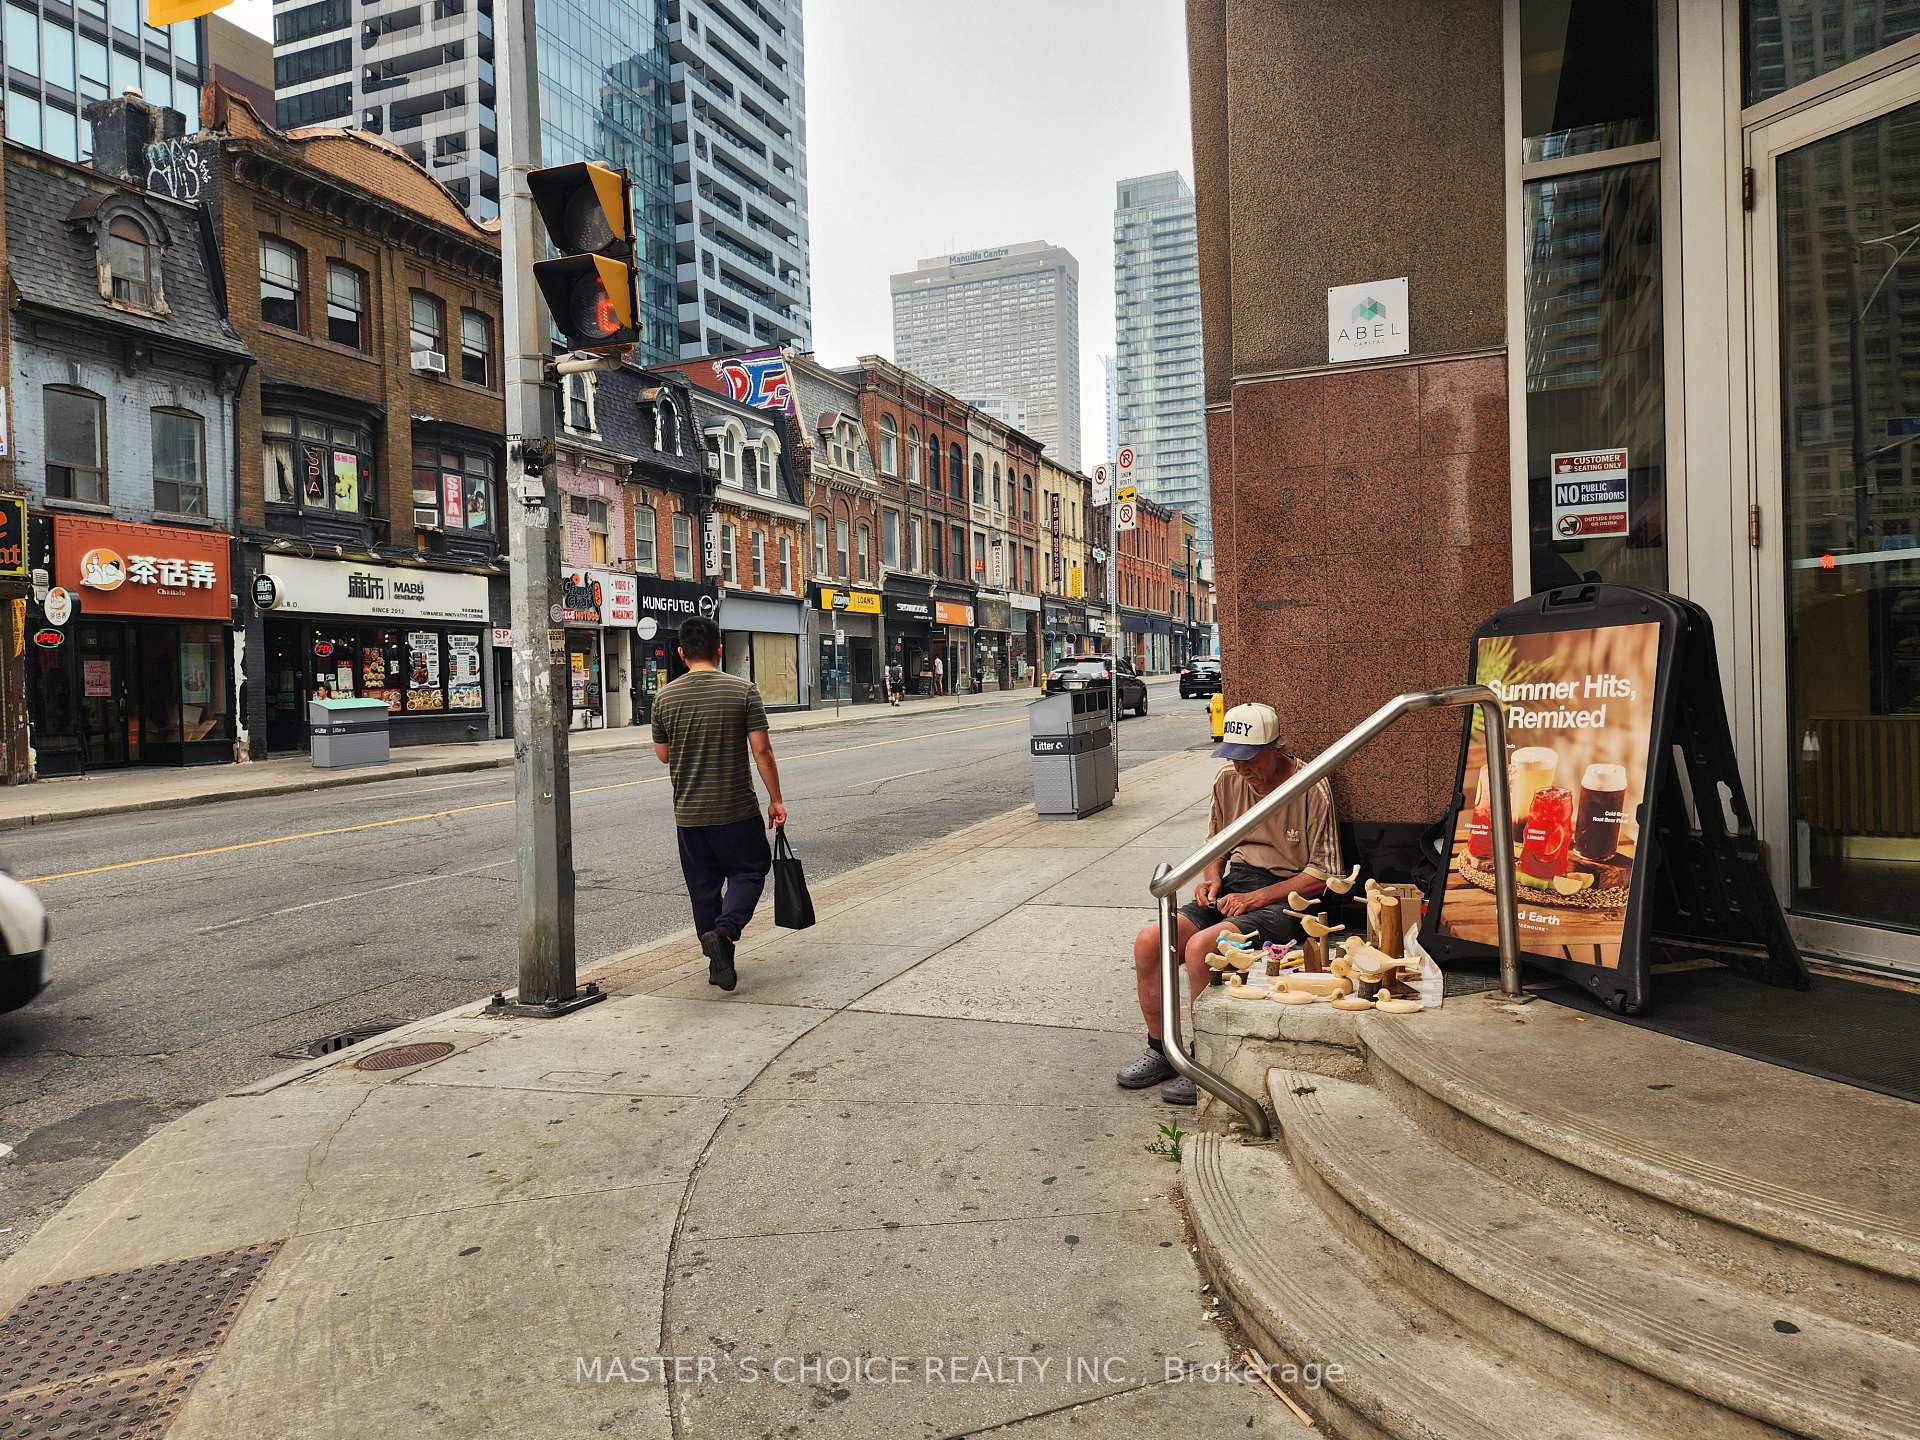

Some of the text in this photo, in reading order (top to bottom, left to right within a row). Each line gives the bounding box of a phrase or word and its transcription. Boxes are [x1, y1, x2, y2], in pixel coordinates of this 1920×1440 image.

[949, 249, 1009, 264] Manulife Centre
[1338, 322, 1401, 342] ABEL
[1573, 454, 1621, 465] CUSTOMER
[1573, 462, 1622, 472] SEATING ONLY
[1557, 485, 1580, 504] NO
[1581, 483, 1607, 493] PUBLIC
[447, 477, 460, 515] SPA
[1581, 491, 1625, 502] RESTROOMS
[642, 596, 696, 613] KUNG FU TEA
[857, 596, 875, 606] LOANS
[391, 607, 405, 615] 2012
[36, 632, 62, 644] OPEN
[1488, 673, 1638, 702] Summer Hits,
[1507, 704, 1607, 729] Remixed
[1034, 741, 1055, 751] Litter
[1528, 911, 1561, 926] Earth
